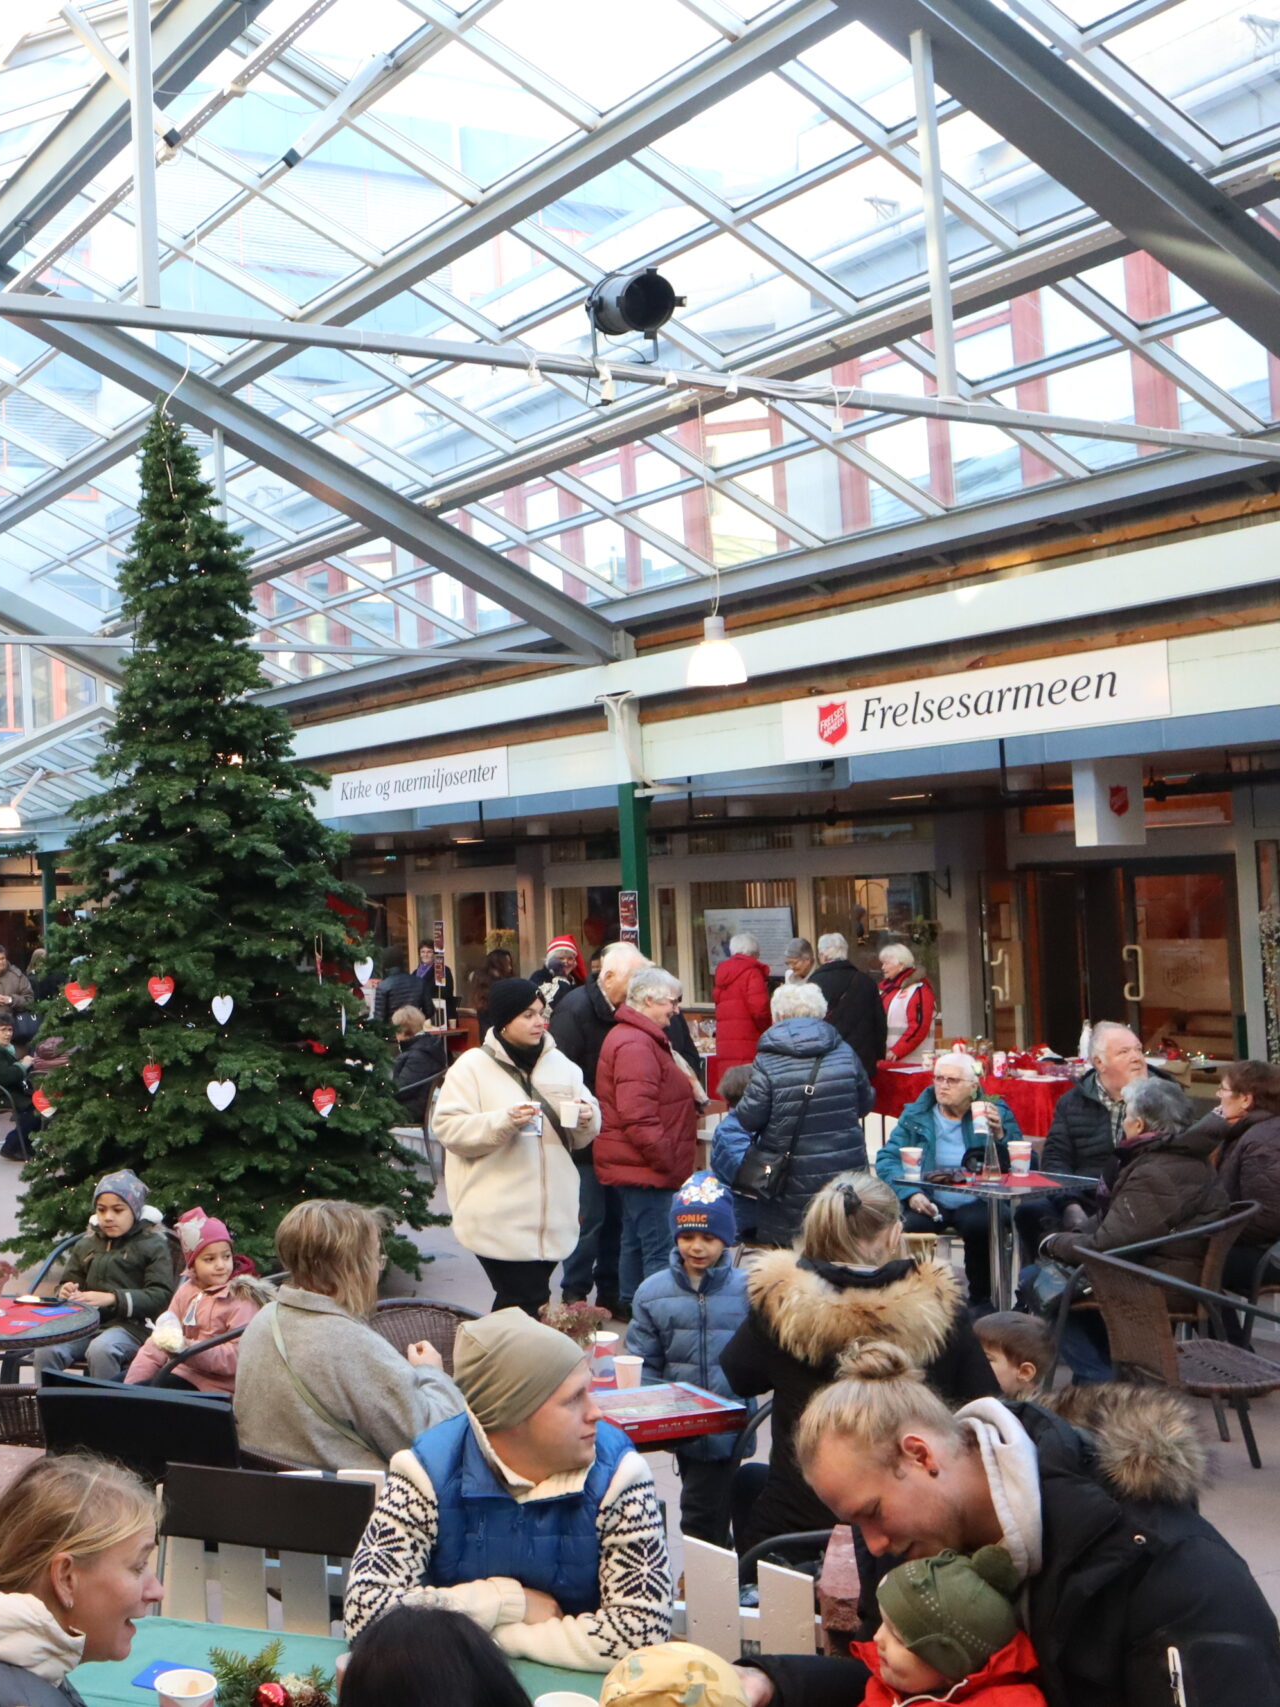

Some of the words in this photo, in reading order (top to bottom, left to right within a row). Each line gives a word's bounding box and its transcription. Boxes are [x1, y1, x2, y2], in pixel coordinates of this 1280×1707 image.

[860, 671, 1117, 732] Frelsesarmeen
[340, 780, 372, 801] Kirke
[375, 782, 391, 801] og
[393, 764, 498, 793] nærmiljøsenter
[675, 1213, 708, 1223] SONIC
